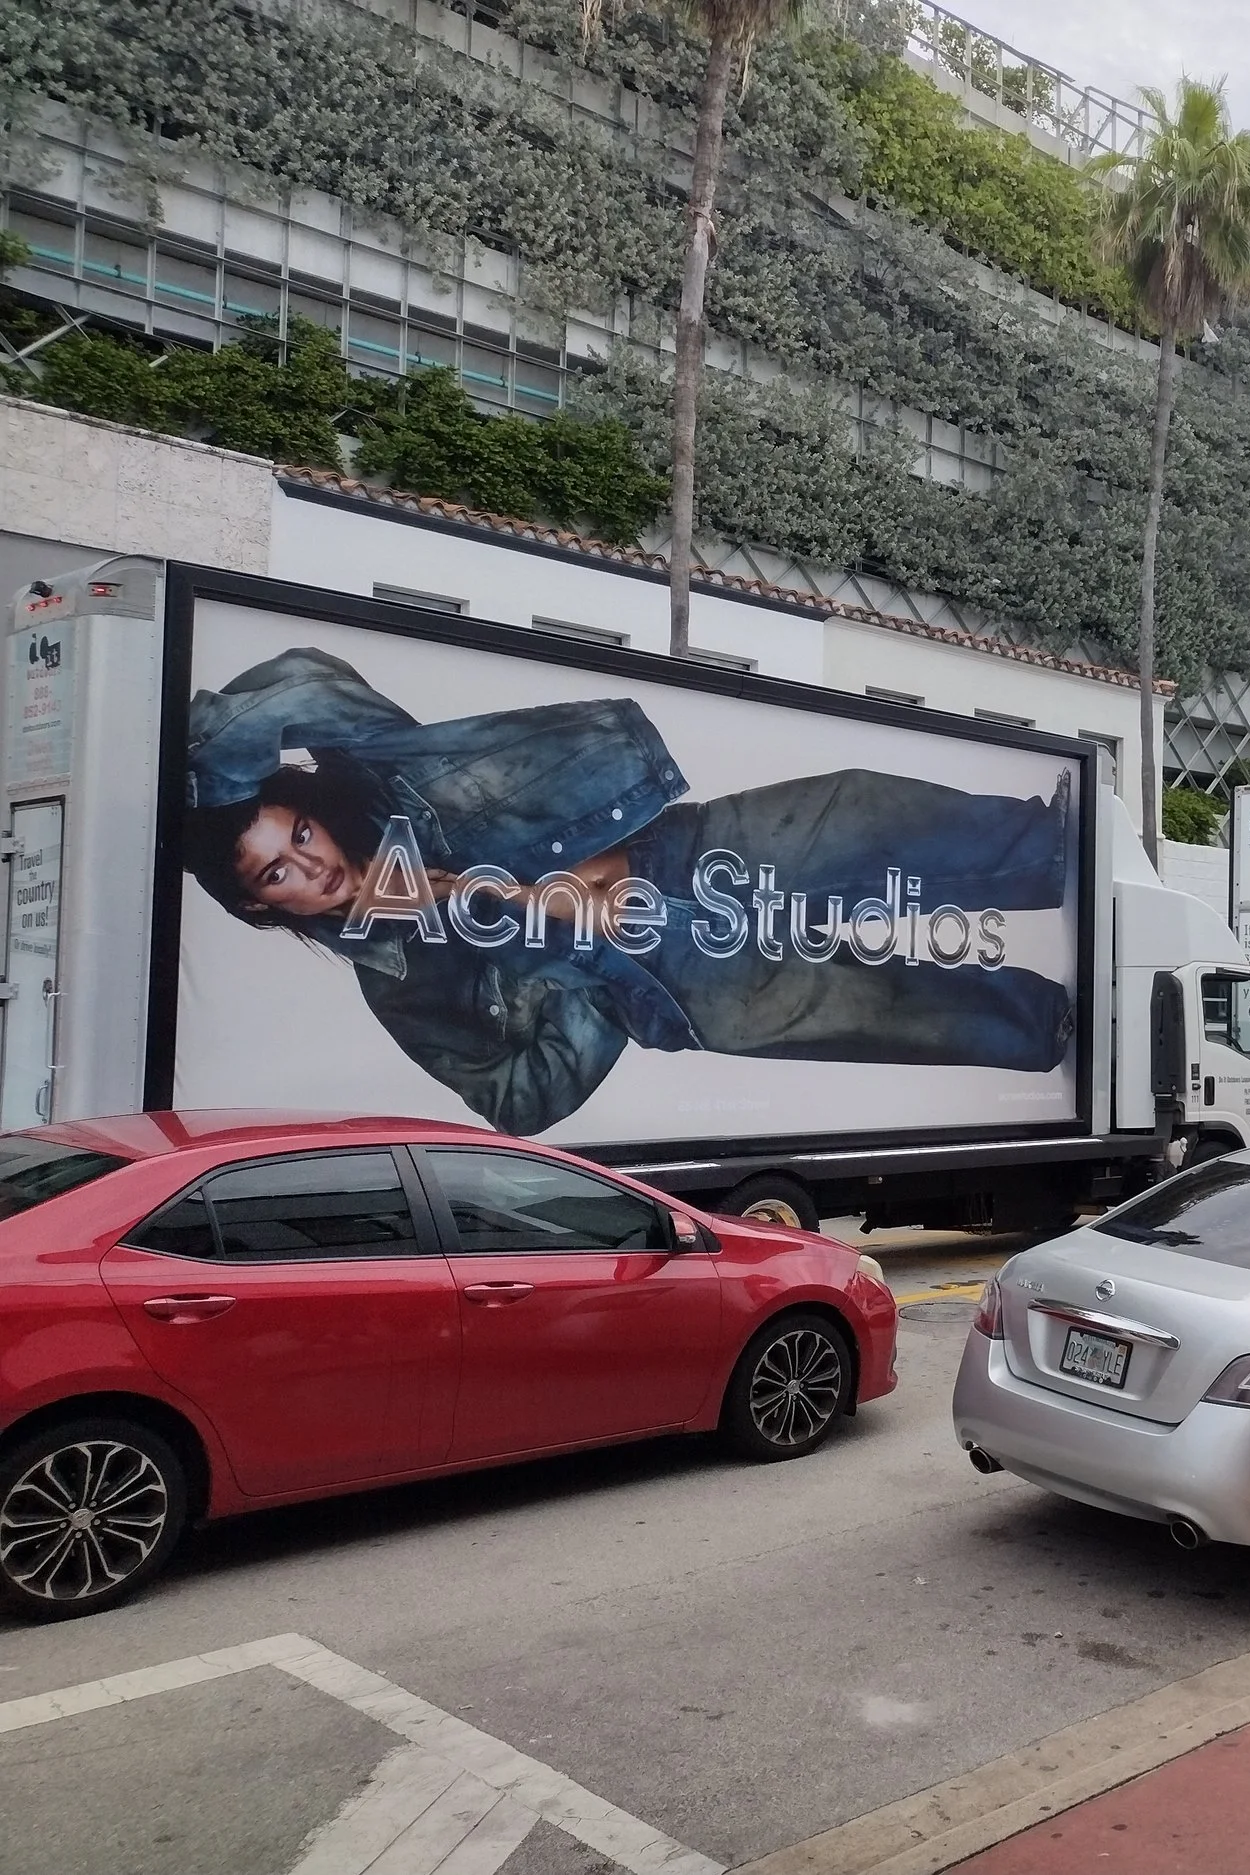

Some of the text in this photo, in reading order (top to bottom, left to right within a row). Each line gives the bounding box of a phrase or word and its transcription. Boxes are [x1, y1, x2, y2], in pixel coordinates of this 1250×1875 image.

[19, 849, 43, 871] Travel
[17, 880, 55, 906] country
[340, 814, 1007, 972] Acne Studios
[21, 906, 48, 929] on us!
[1100, 1350, 1124, 1376] YLE
